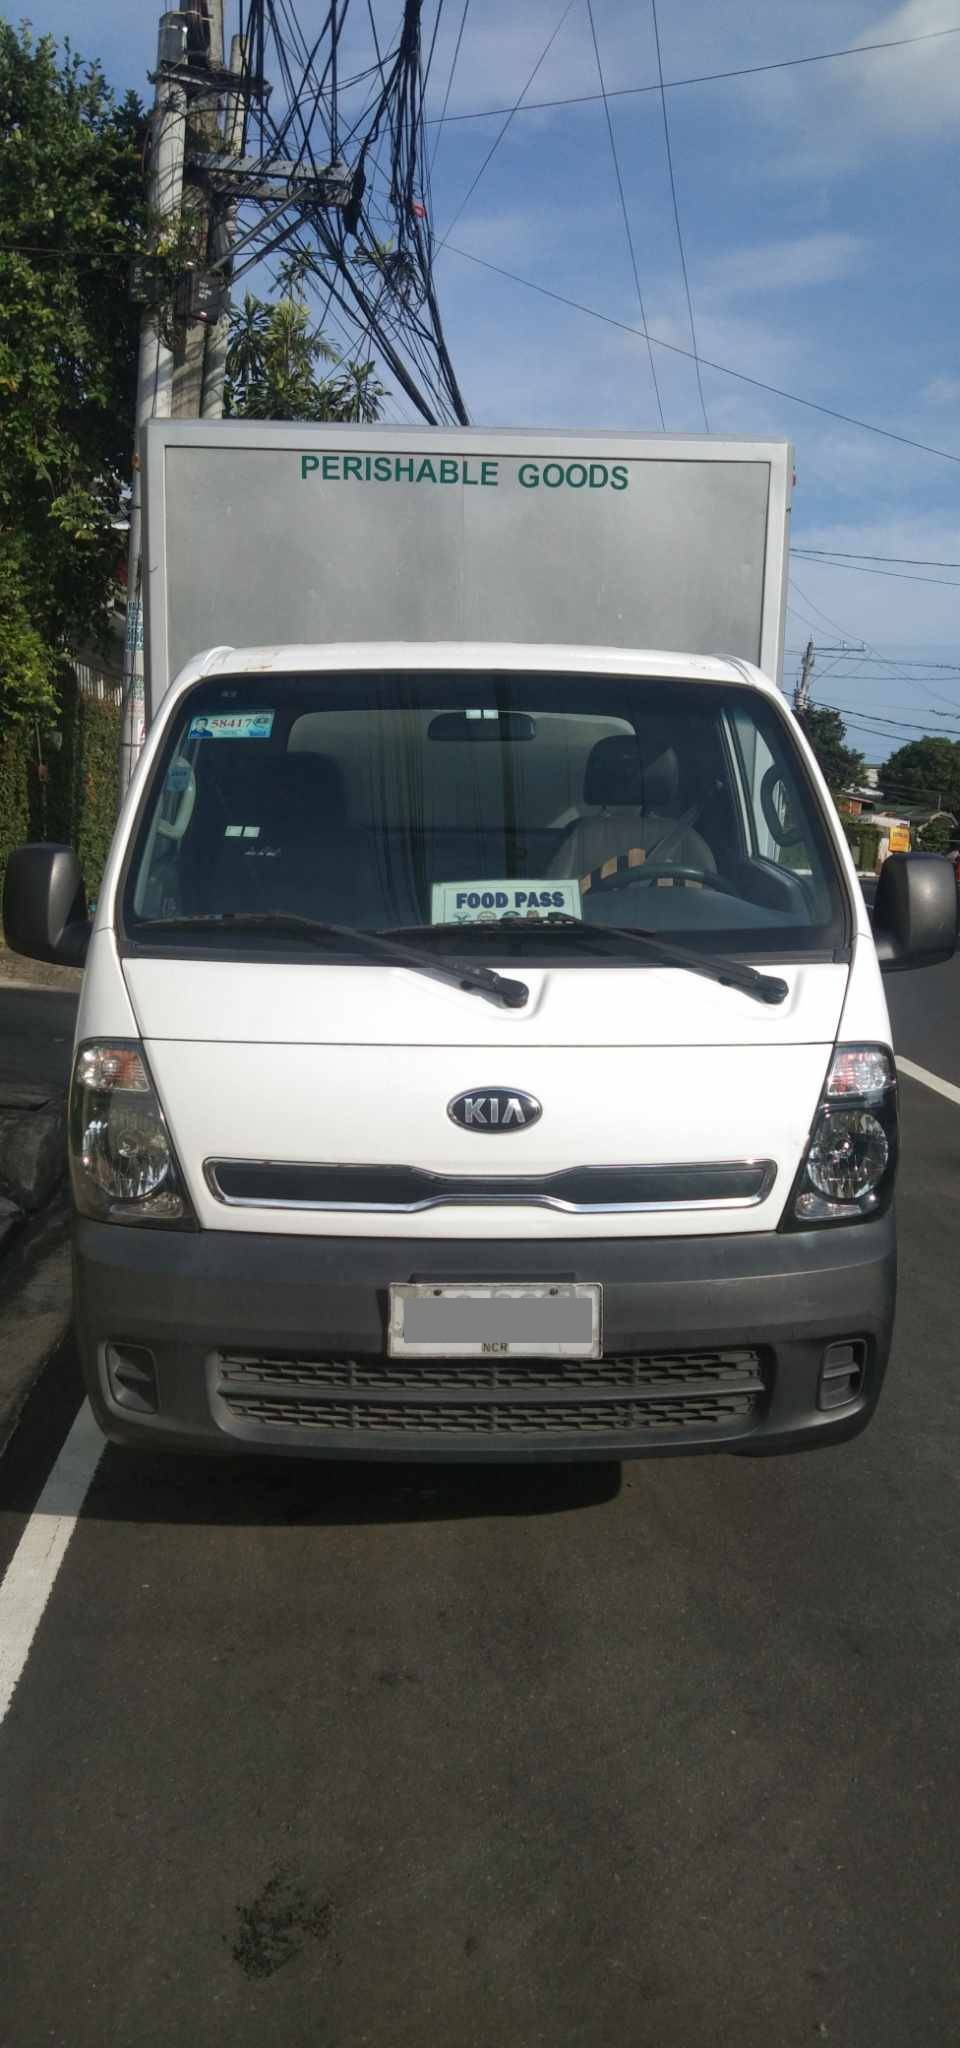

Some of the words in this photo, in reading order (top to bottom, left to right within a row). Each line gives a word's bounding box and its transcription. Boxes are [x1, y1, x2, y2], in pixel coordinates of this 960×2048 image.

[301, 455, 499, 486] PERISHABLE
[518, 463, 629, 490] GOODS
[456, 892, 509, 909] FOOD
[515, 891, 565, 908] PASS
[464, 1098, 526, 1123] KIA
[482, 1342, 509, 1353] NCR
